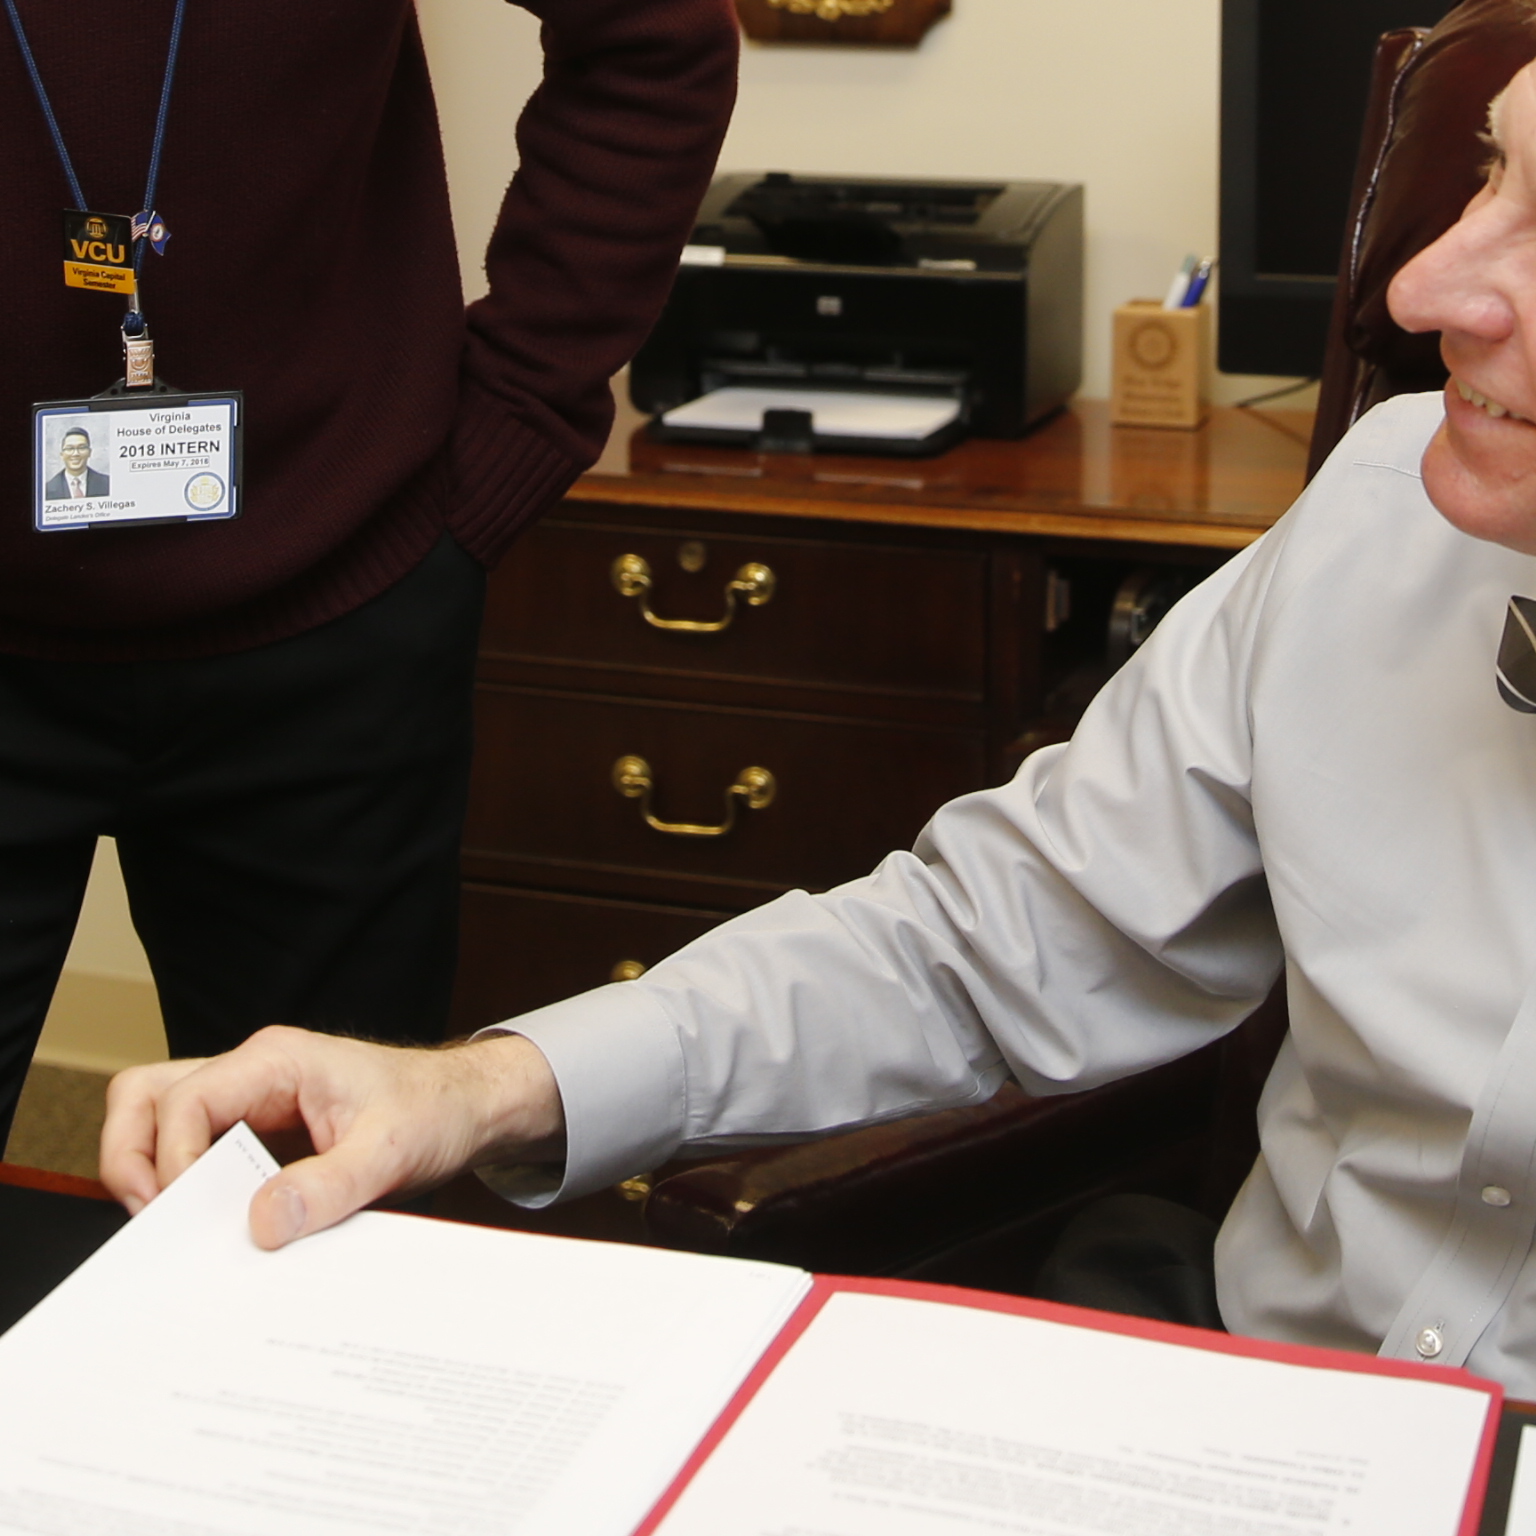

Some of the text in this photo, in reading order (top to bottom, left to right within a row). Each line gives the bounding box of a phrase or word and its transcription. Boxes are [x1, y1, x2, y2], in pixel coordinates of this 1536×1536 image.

[70, 239, 125, 263] VCU
[72, 267, 126, 281] Virginia Capital
[83, 278, 117, 289] Semester
[149, 411, 191, 424] Virginia
[117, 422, 222, 438] House of Delegates
[119, 440, 221, 459] 2018 INTERN
[131, 460, 162, 471] Expires
[163, 459, 179, 469] May
[181, 459, 189, 467] 7,
[45, 499, 136, 515] Zachery S. Villegas
